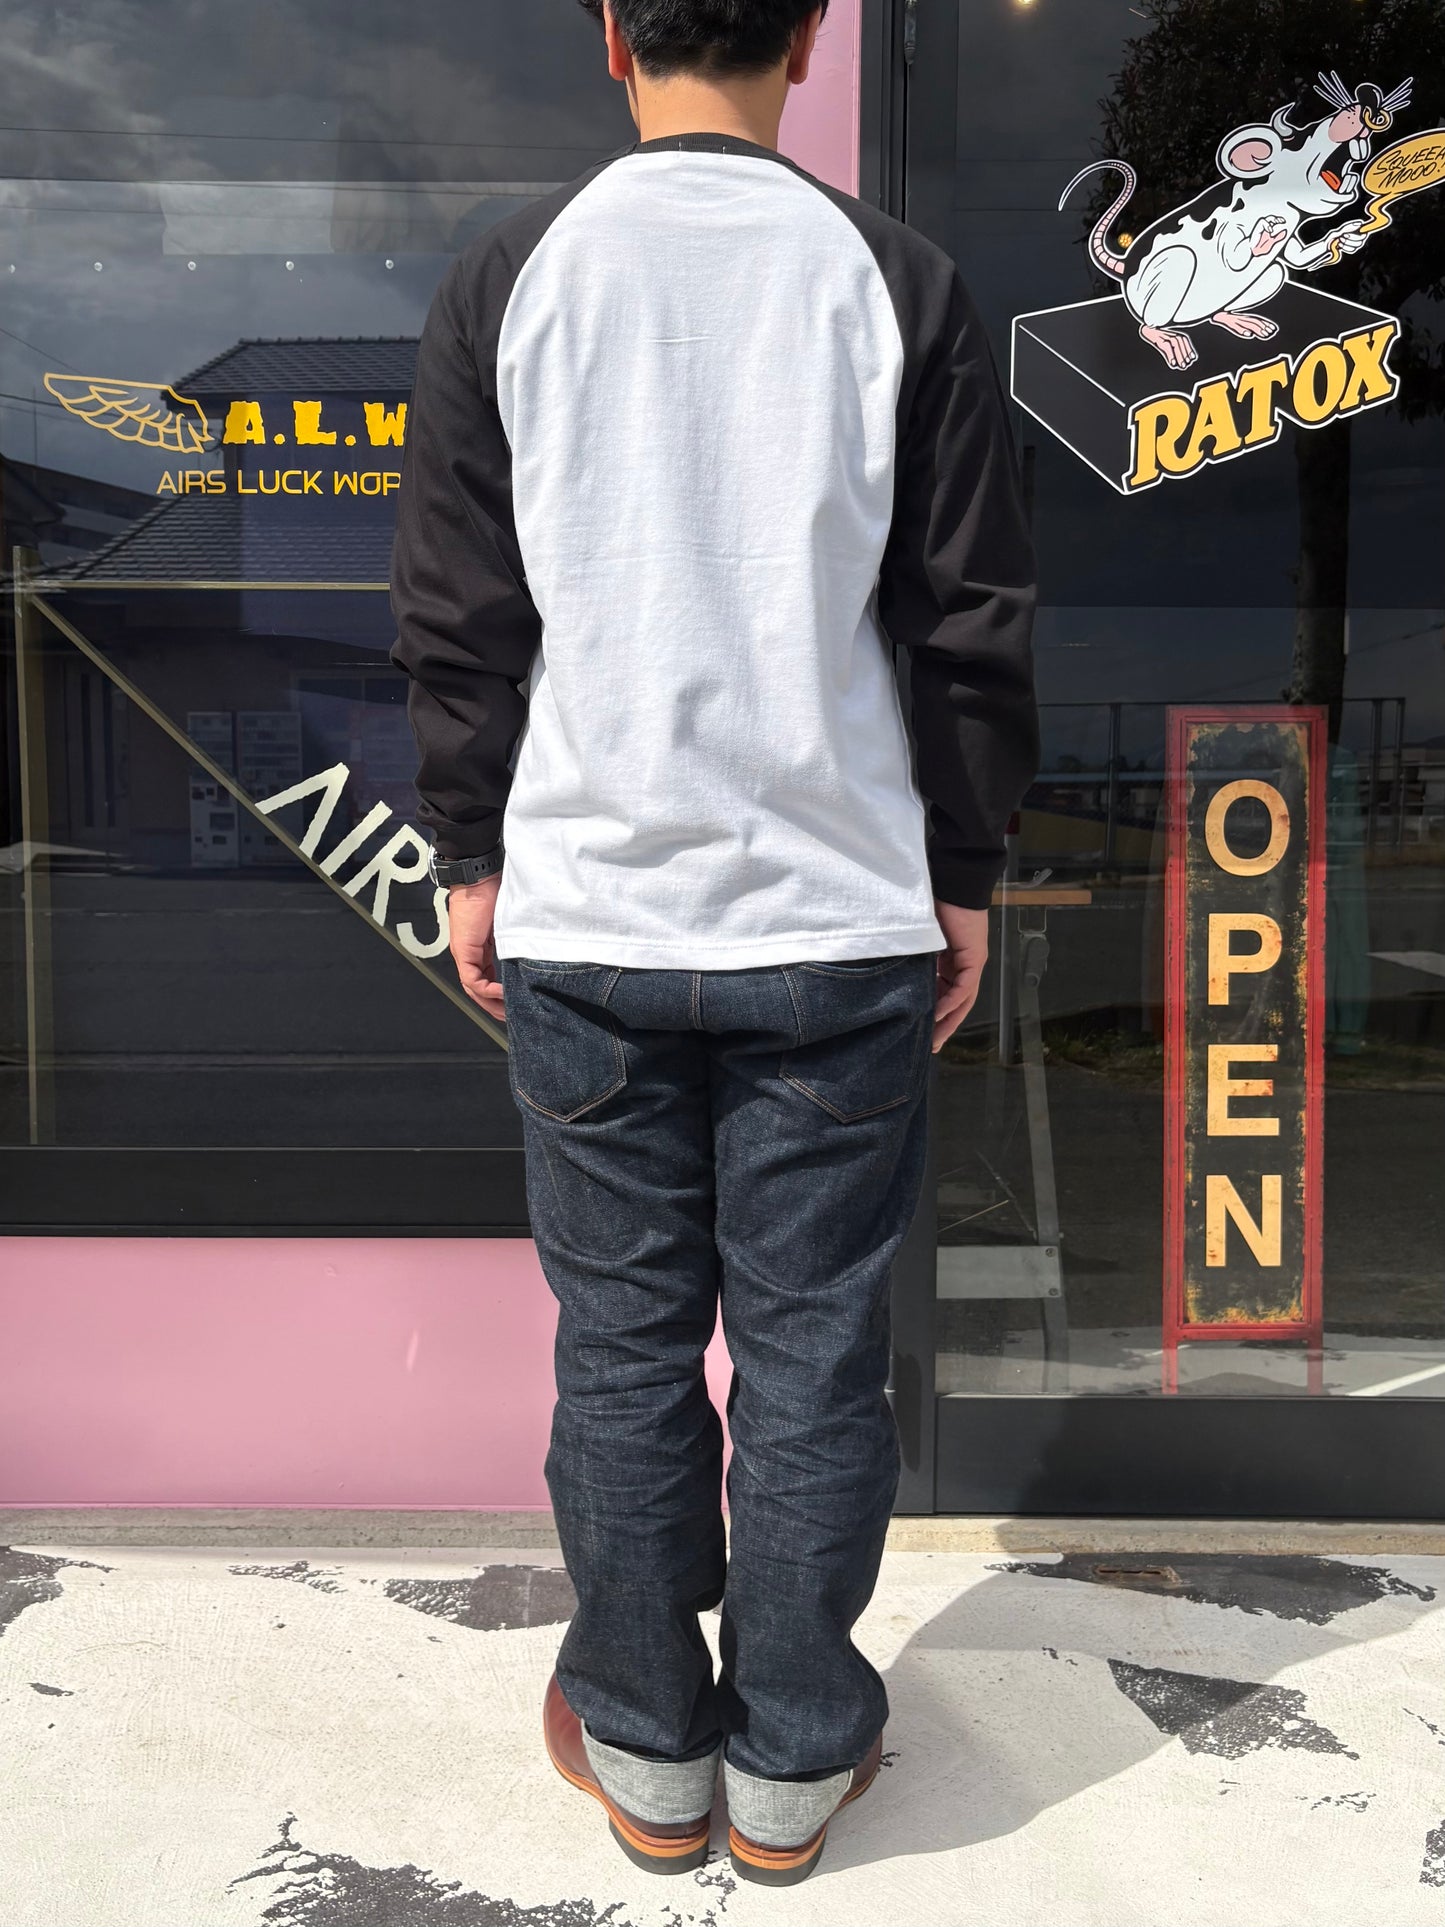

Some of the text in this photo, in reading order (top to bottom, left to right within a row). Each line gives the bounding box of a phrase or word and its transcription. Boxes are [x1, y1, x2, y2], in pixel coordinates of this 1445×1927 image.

[156, 470, 227, 494] AIRS
[237, 470, 323, 495] LUCK
[1130, 325, 1395, 486] RATOX
[1205, 779, 1290, 1267] OPEN
